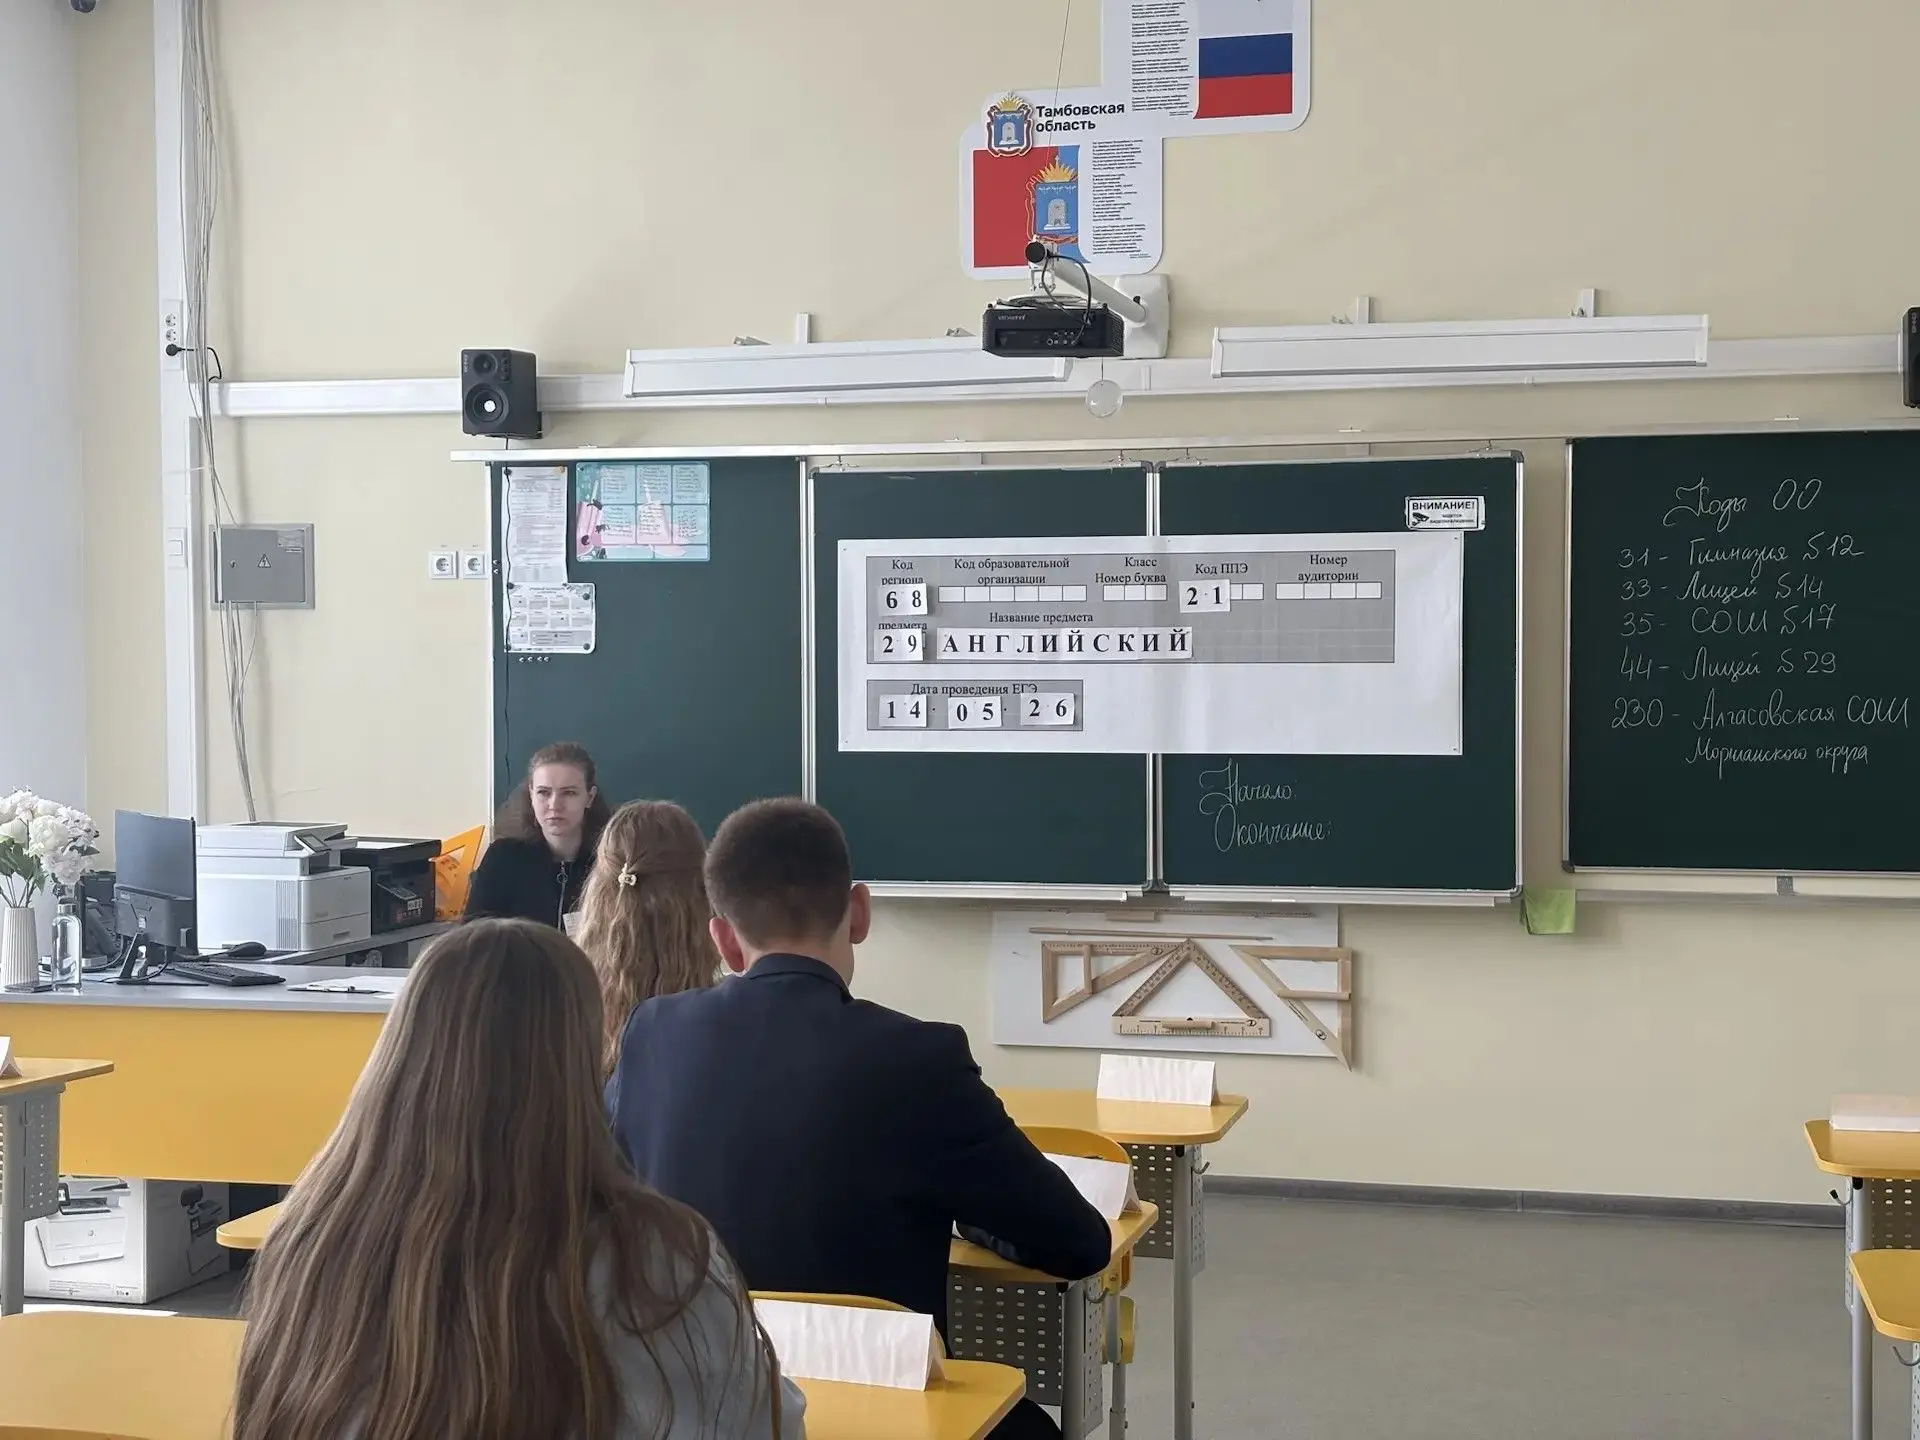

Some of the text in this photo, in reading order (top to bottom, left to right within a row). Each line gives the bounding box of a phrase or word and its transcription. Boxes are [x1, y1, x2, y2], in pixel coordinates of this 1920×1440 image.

[1035, 104, 1125, 118] Тамбовская
[1036, 120, 1096, 132] область
[1412, 501, 1475, 510] ВНИМАНИЕ!
[1662, 477, 1747, 532] Коды
[892, 559, 914, 570] Код
[953, 558, 1070, 571] Код образовательной
[1124, 557, 1158, 567] Класс
[1310, 555, 1348, 567] Номер
[1689, 537, 1788, 579] Гимназия
[1195, 563, 1248, 575] Код ППЭ
[881, 576, 924, 585] региона
[977, 575, 1046, 586] организации
[1095, 572, 1166, 585] Номер буква
[1678, 570, 1758, 604] Лицей
[989, 612, 1093, 625] Название предмета
[1691, 606, 1768, 635] СОШ
[943, 629, 1189, 653] АНГЛИЙСКИЙ
[1683, 646, 1761, 682] Лицей
[911, 683, 1038, 697] Дата проведения ЕГЭ
[1693, 688, 1835, 730] Алгасовская
[1846, 695, 1909, 728] СОШ
[1816, 746, 1869, 774] округа
